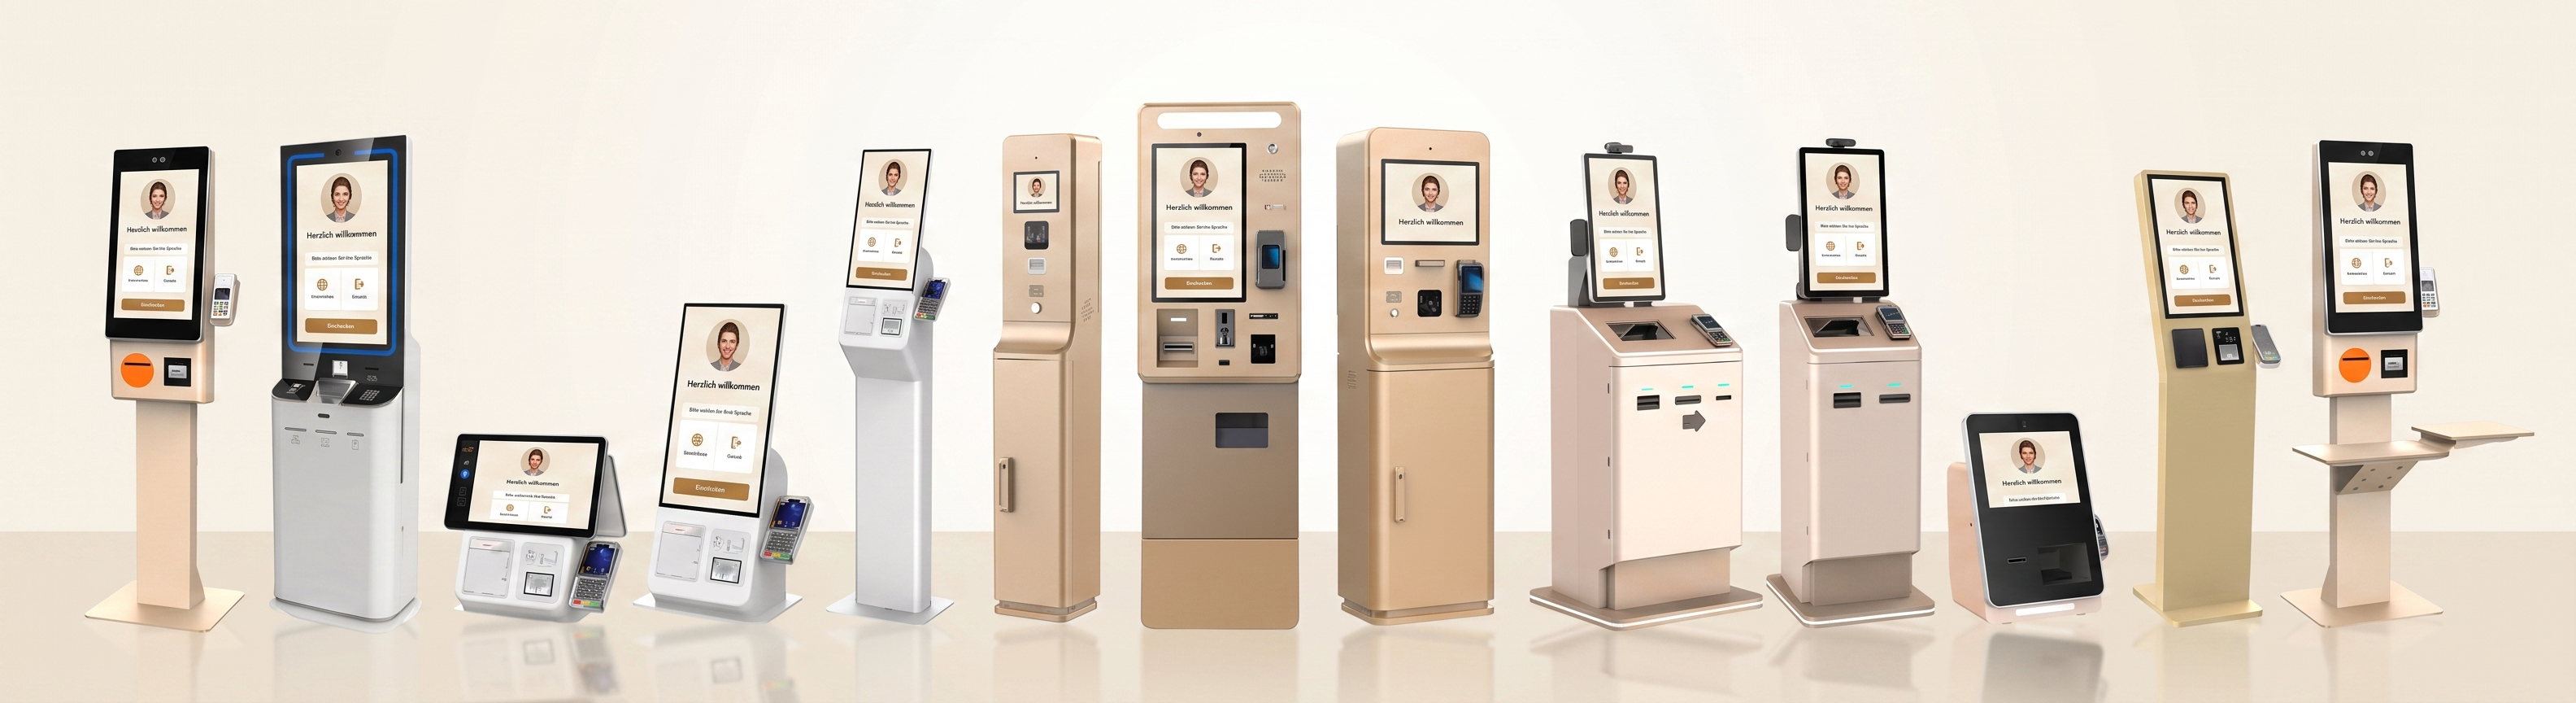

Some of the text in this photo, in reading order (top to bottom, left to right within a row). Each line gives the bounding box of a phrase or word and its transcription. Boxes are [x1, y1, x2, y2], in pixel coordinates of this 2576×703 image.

[1425, 218, 1464, 226] willkommen
[2365, 217, 2401, 225] willkommen
[151, 225, 188, 233] willkommen
[307, 230, 334, 239] Herzlich
[687, 379, 760, 391] Herzlich willkommen
